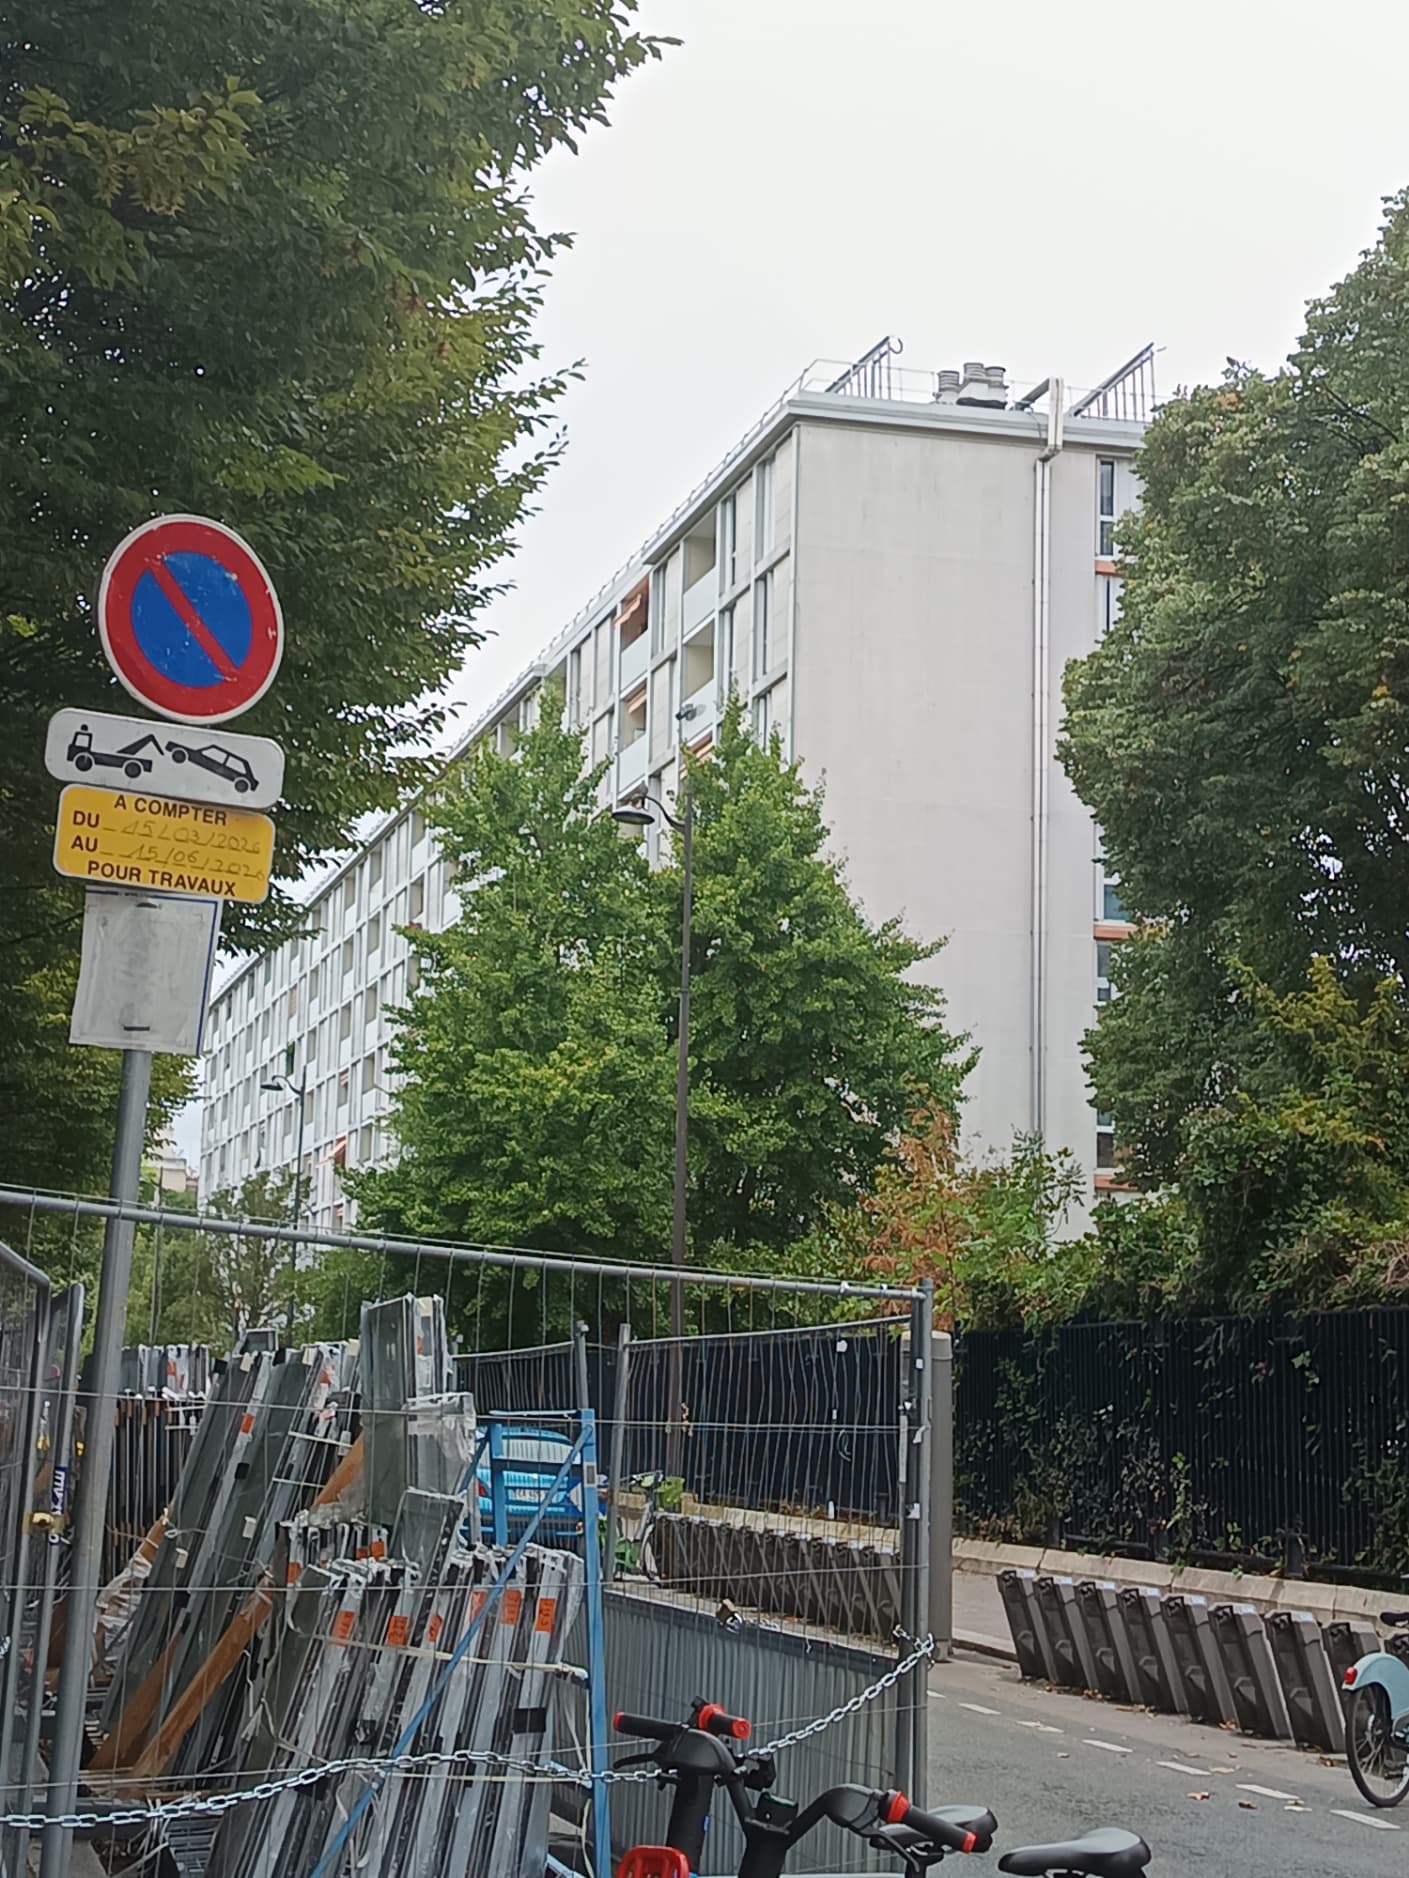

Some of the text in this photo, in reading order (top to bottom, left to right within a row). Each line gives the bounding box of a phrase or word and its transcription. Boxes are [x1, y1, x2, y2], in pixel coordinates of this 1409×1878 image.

[72, 810, 100, 828] DU
[134, 797, 227, 826] COMPTER
[71, 835, 98, 852] AU
[87, 860, 236, 896] POUR TRAVAUX
